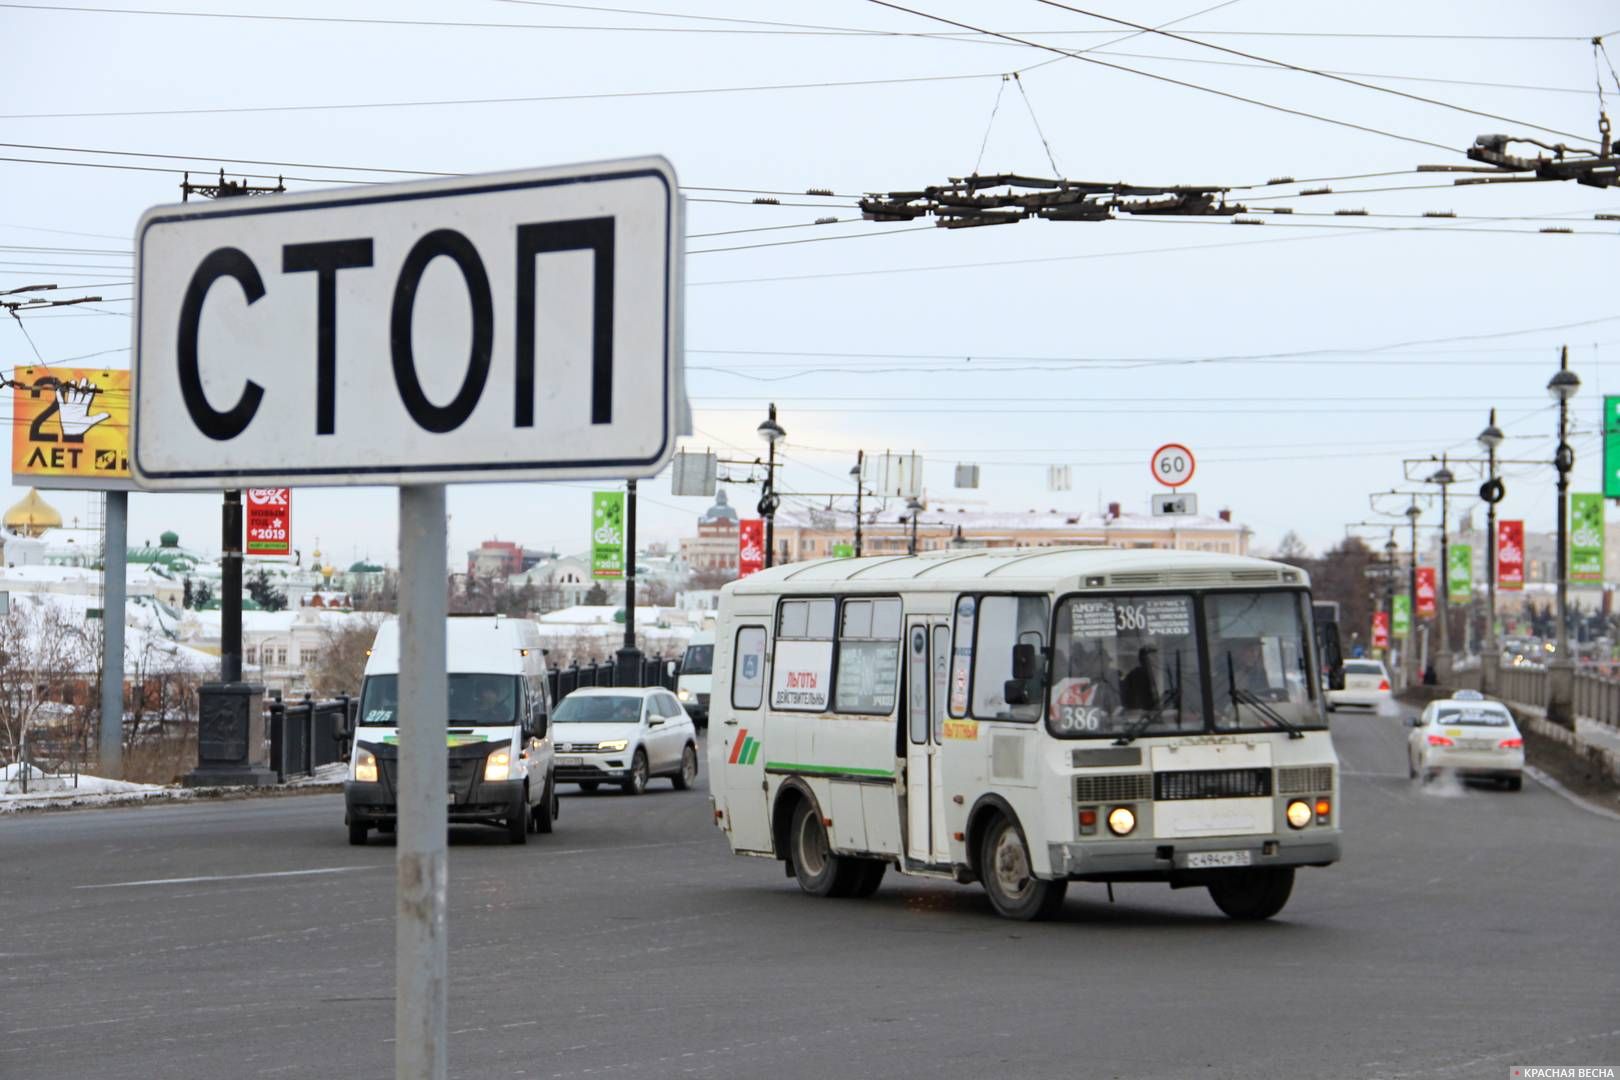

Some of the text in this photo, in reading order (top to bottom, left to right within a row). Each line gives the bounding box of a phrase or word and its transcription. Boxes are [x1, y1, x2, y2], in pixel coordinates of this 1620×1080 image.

[177, 216, 615, 440] СТОП
[27, 446, 83, 469] ЛЕТ
[1161, 456, 1185, 473] 60
[258, 528, 286, 540] 2019
[1116, 604, 1146, 631] 386
[786, 672, 818, 689] ЛЬГОТЫ
[775, 690, 826, 705] ДЕЙСТВИТЕЛЬНЫ
[1061, 706, 1100, 731] 386
